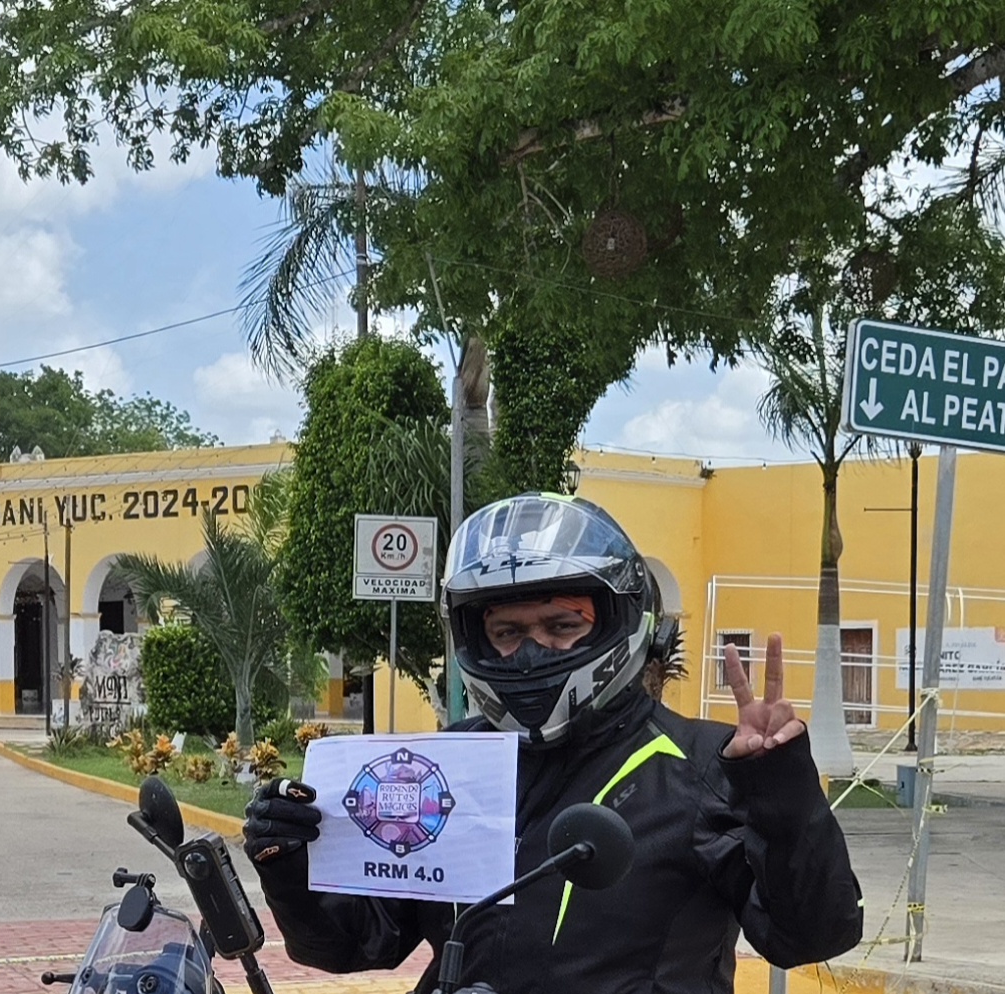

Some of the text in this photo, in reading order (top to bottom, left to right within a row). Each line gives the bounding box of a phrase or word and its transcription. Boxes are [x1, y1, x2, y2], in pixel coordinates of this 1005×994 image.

[860, 336, 937, 380] CEDA
[943, 349, 976, 386] EL
[900, 388, 936, 425] AL
[382, 533, 407, 552] 20
[363, 578, 426, 587] VELOCIDAD
[372, 586, 416, 595] MAXIMA
[396, 752, 409, 761] N
[395, 844, 406, 854] S
[364, 861, 445, 883] RRM 4.0
